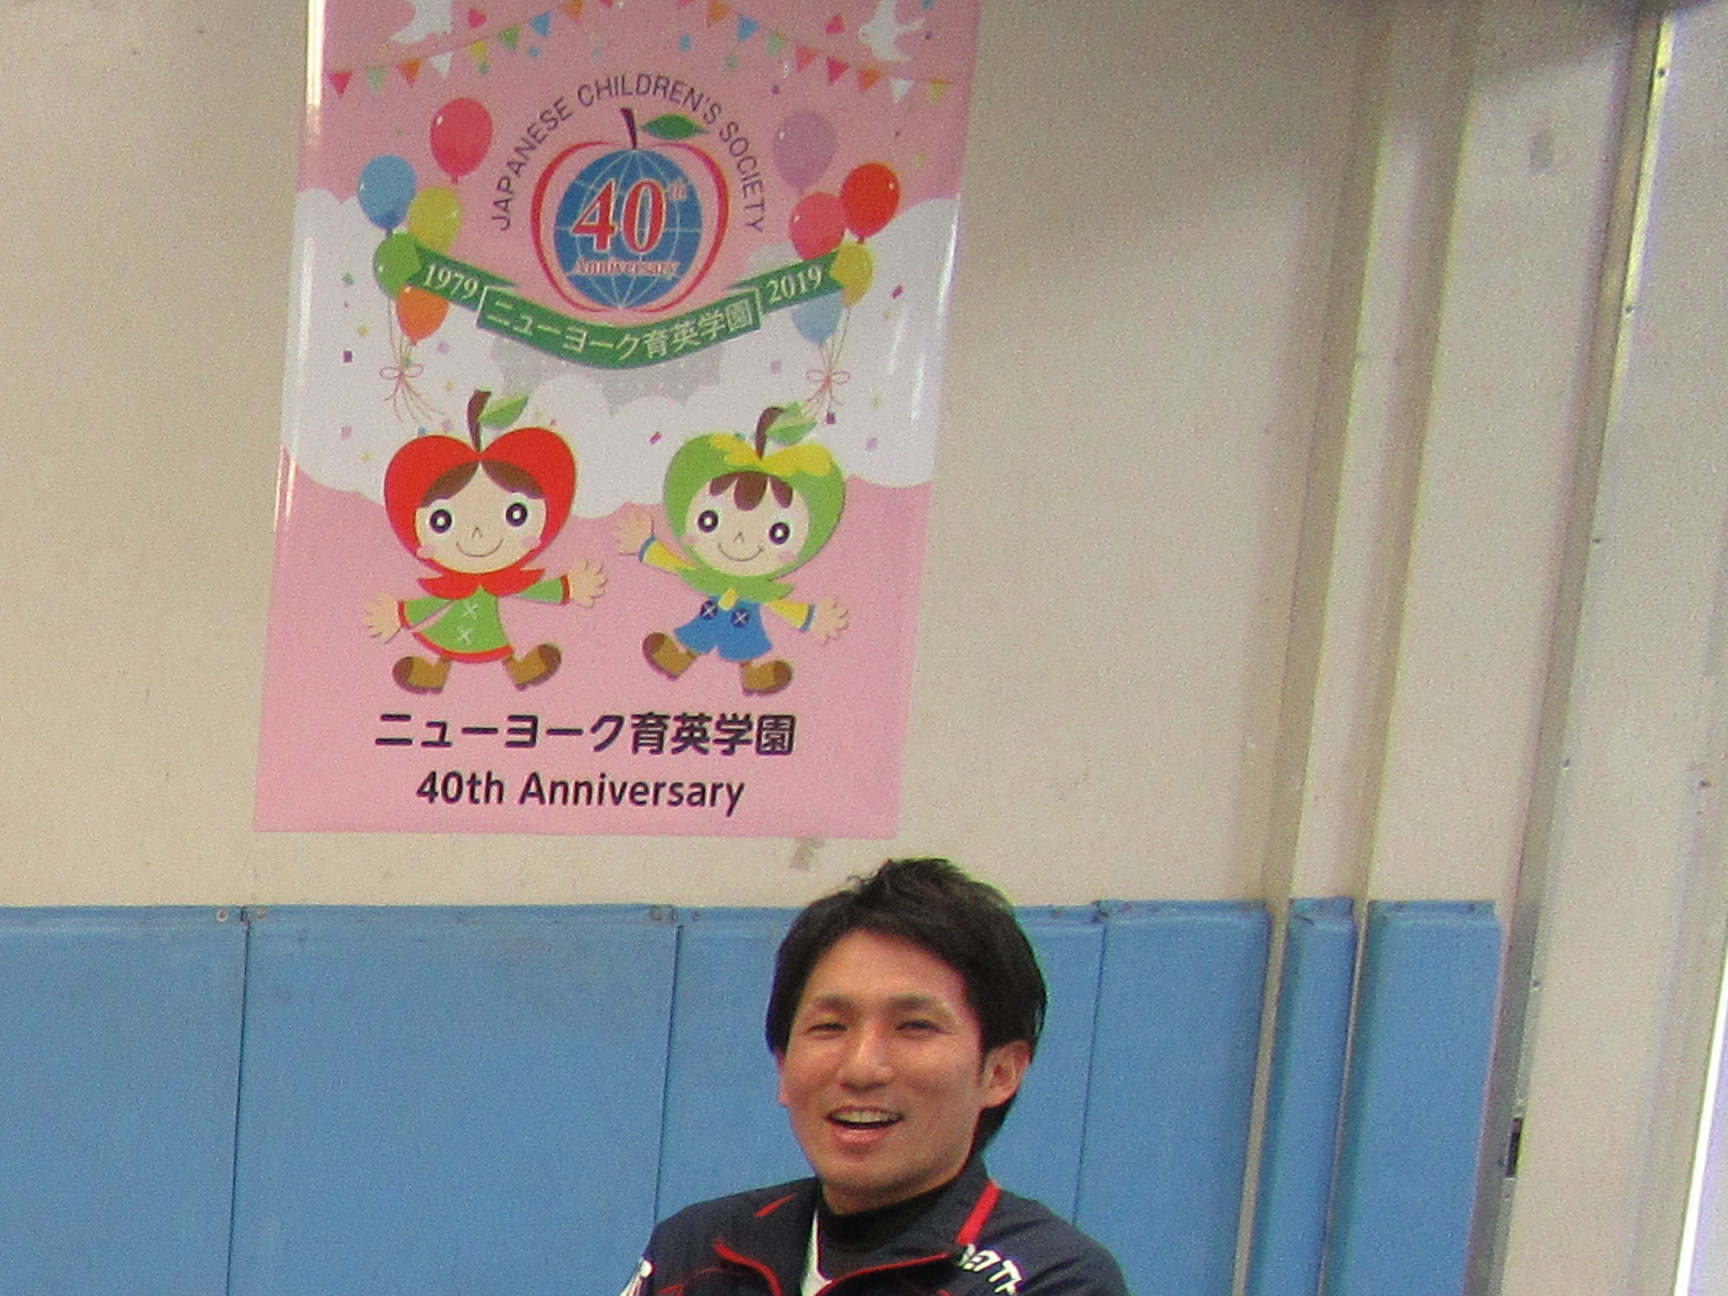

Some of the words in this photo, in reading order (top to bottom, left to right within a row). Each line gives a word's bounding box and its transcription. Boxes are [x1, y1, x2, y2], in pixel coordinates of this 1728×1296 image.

[491, 96, 573, 232] JAPANESE
[577, 73, 722, 125] CHILDREN'S
[718, 121, 765, 233] SOCIETY
[424, 262, 481, 299] 1979
[574, 257, 680, 280] Anniversary
[765, 264, 824, 304] 2019
[486, 292, 757, 362] ニューヨーク育英学園
[374, 712, 797, 757] ニューヨーク育英学園
[416, 770, 505, 806] 40th
[519, 772, 745, 817] Anniversary
